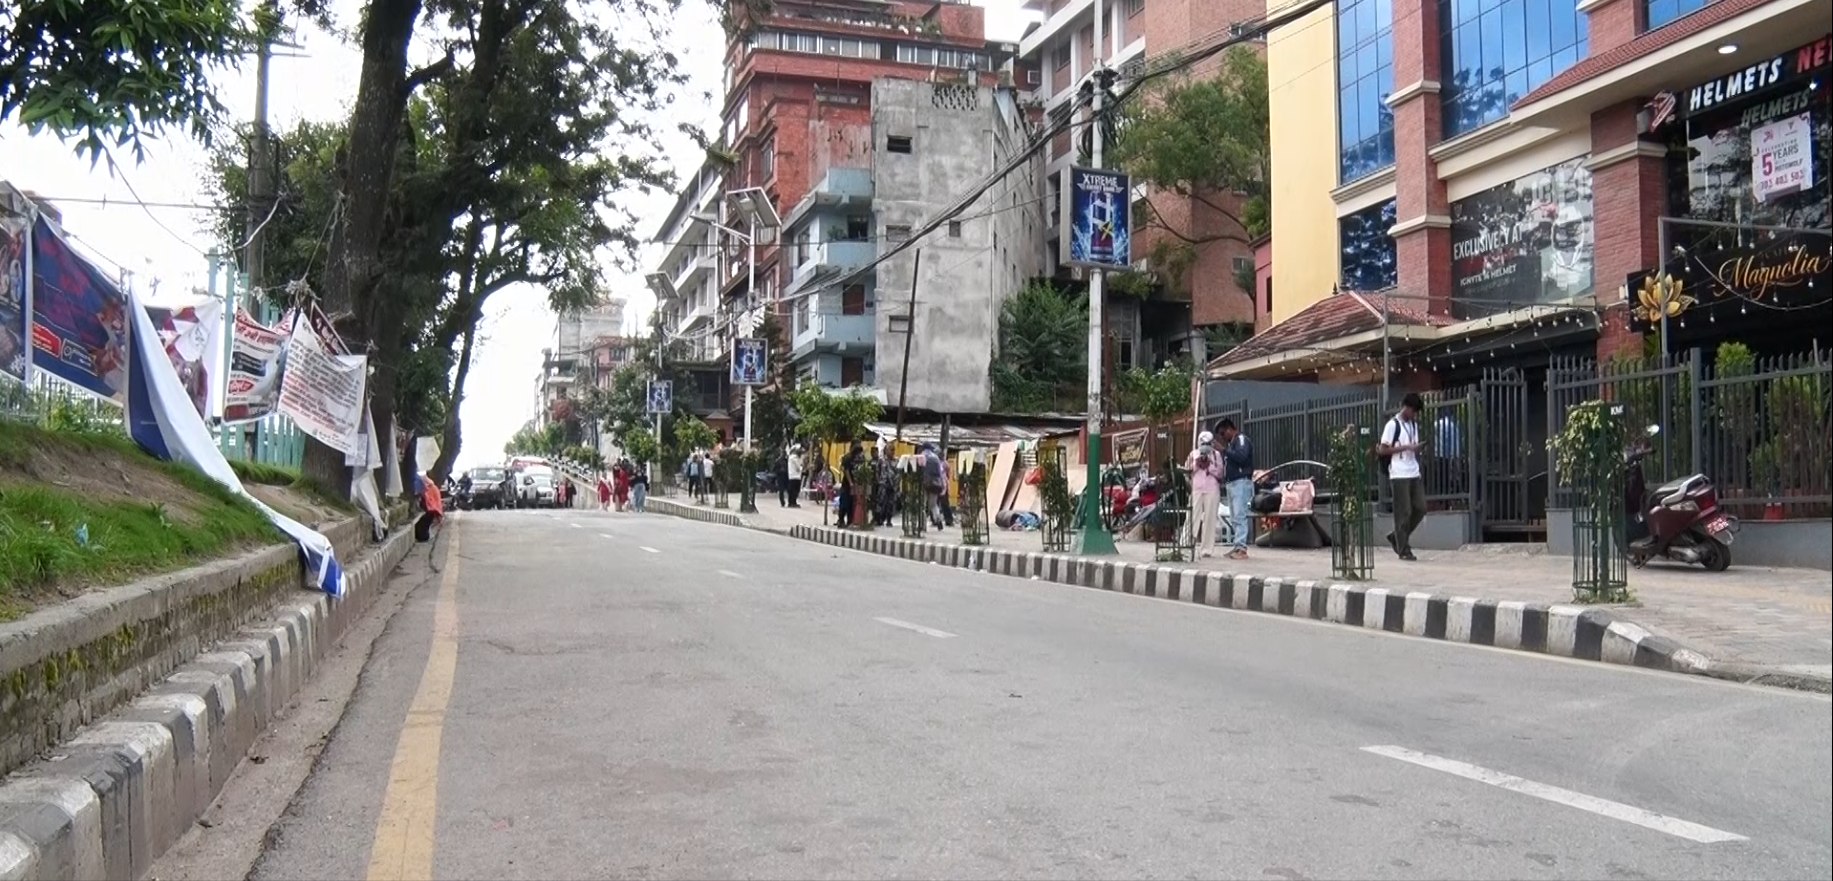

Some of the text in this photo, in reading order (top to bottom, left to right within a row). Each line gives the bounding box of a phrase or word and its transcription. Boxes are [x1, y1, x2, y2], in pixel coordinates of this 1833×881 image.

[1689, 57, 1782, 112] HELMETS
[1740, 90, 1810, 127] HELMETS
[1762, 144, 1799, 176] 5 YEARS
[1082, 173, 1118, 187] XTREME
[1491, 264, 1517, 279] HELMET
[1719, 244, 1829, 300] Magnolia
